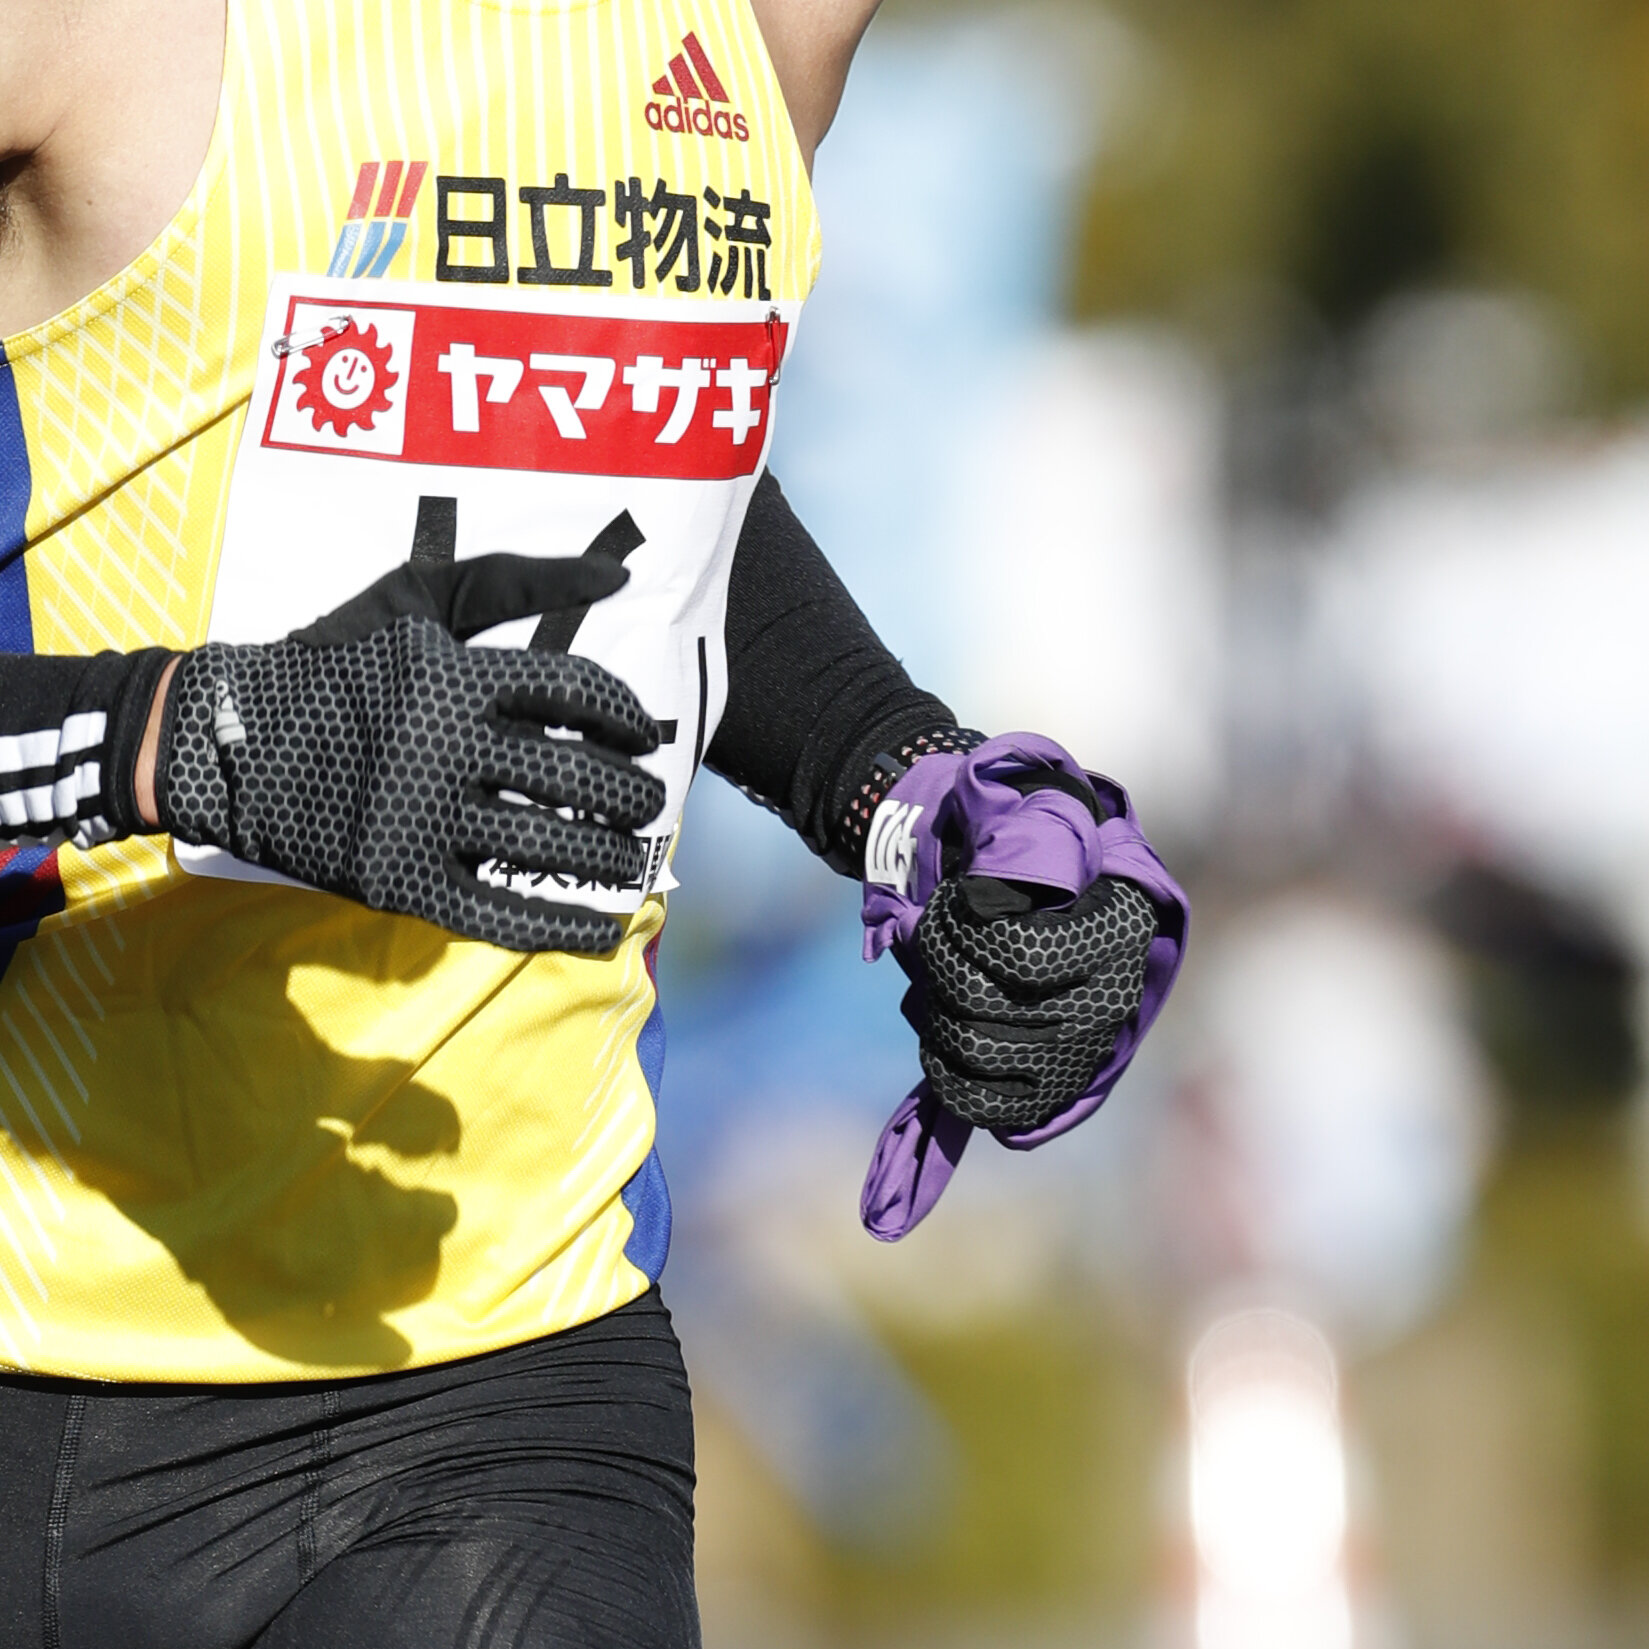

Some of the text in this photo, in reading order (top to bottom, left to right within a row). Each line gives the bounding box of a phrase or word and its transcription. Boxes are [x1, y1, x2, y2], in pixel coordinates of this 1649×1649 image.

[644, 97, 750, 142] adidas
[435, 172, 773, 301] 日立物流
[437, 342, 767, 446] ヤマザキ
